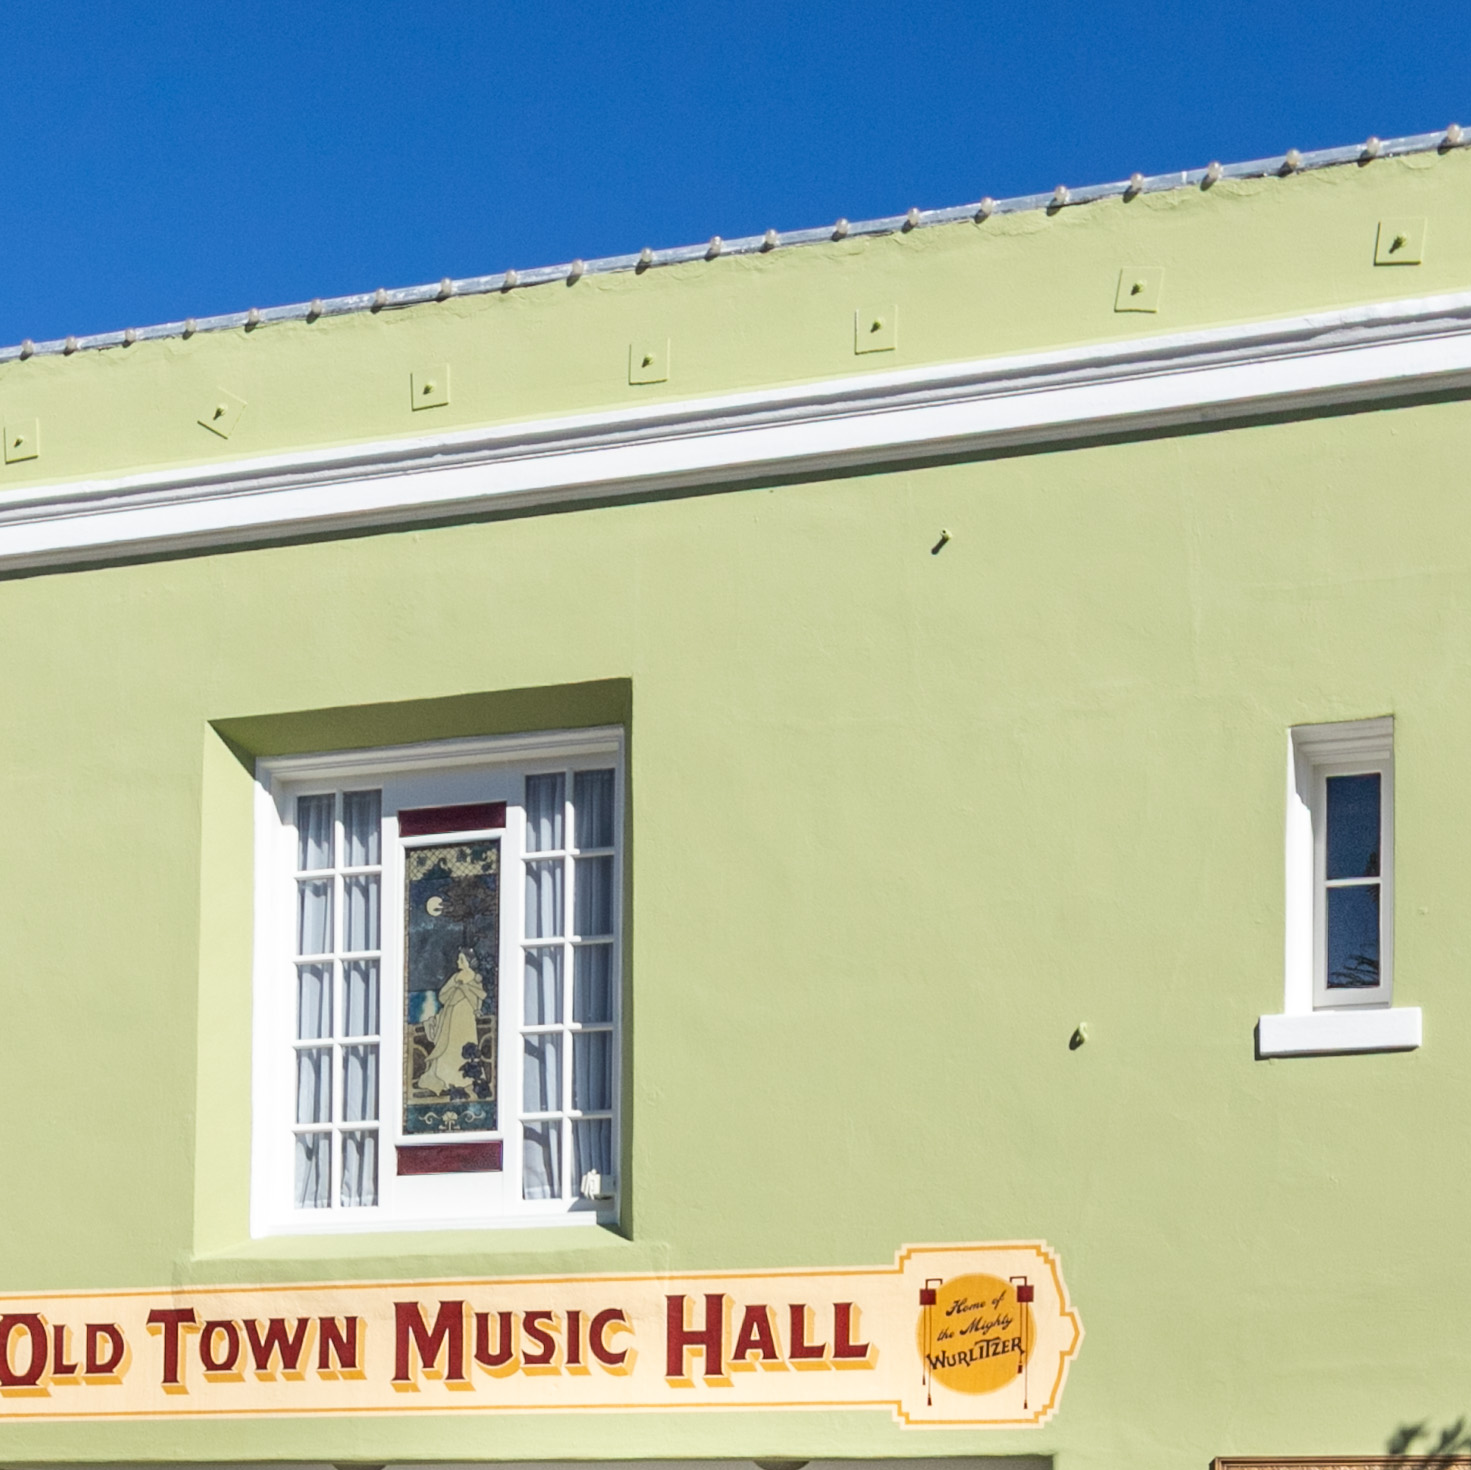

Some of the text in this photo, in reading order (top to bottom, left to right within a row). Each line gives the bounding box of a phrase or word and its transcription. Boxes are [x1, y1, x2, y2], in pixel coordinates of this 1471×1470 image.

[945, 1290, 1007, 1316] Home of
[145, 1306, 362, 1389] TOWN
[391, 1299, 634, 1388] MUSIC
[664, 1292, 875, 1383] HALL
[936, 1313, 1014, 1341] the Mighty
[926, 1336, 1025, 1370] WURLITZER
